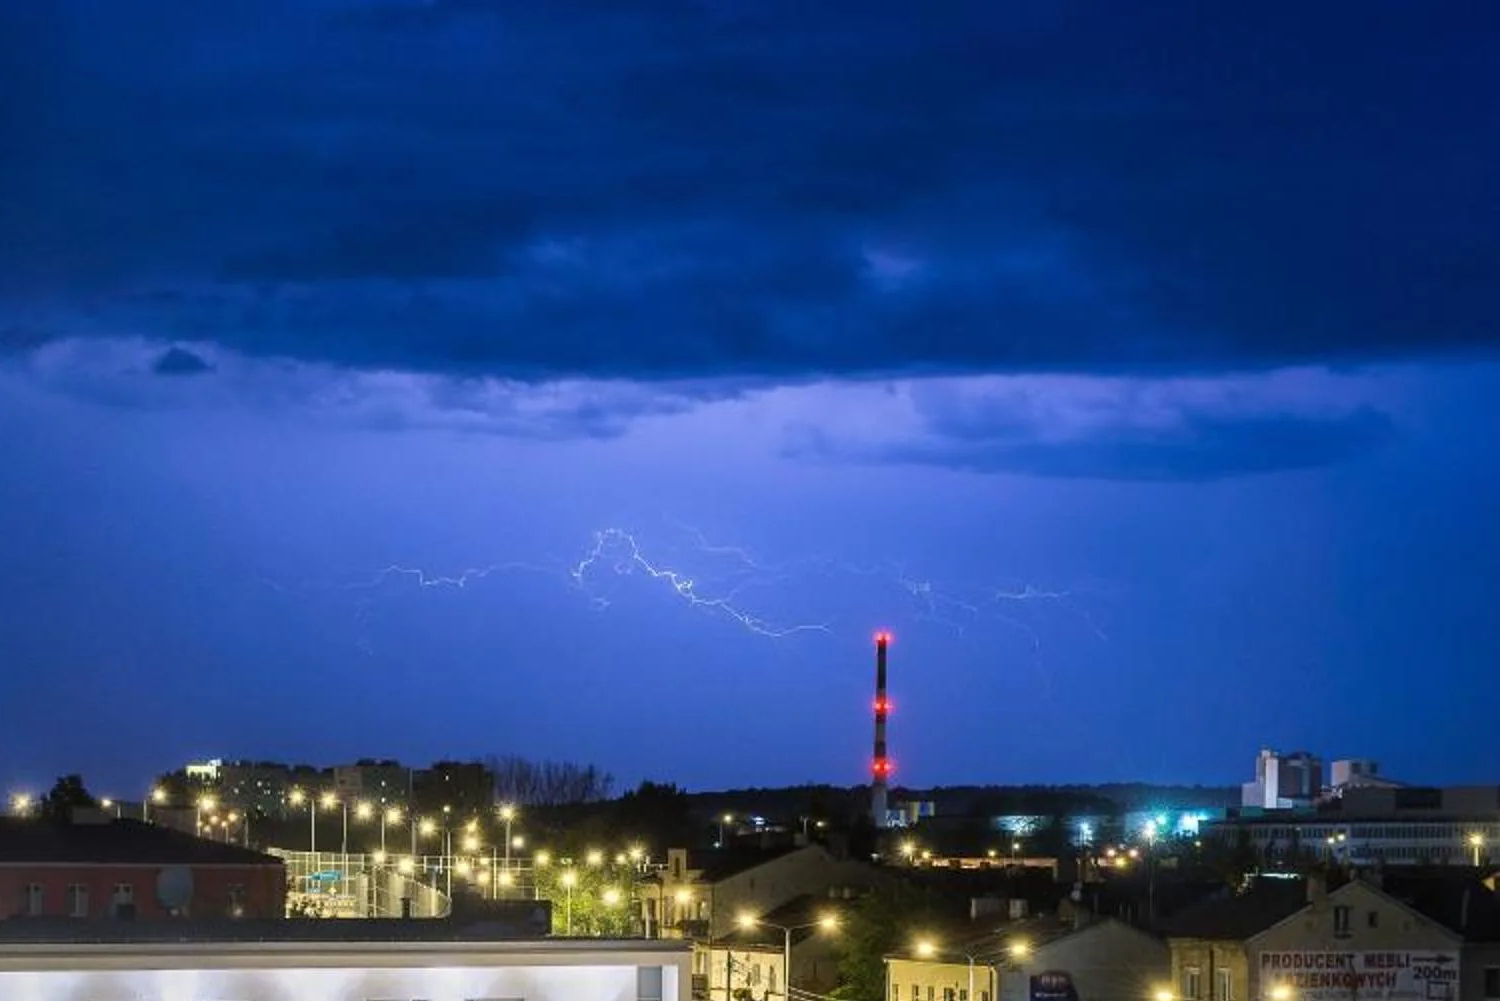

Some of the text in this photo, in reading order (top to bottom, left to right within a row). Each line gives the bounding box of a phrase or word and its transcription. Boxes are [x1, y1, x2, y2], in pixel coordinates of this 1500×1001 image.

[1261, 952, 1411, 969] PRODUCENT MEBLI
[1414, 965, 1457, 979] 200m
